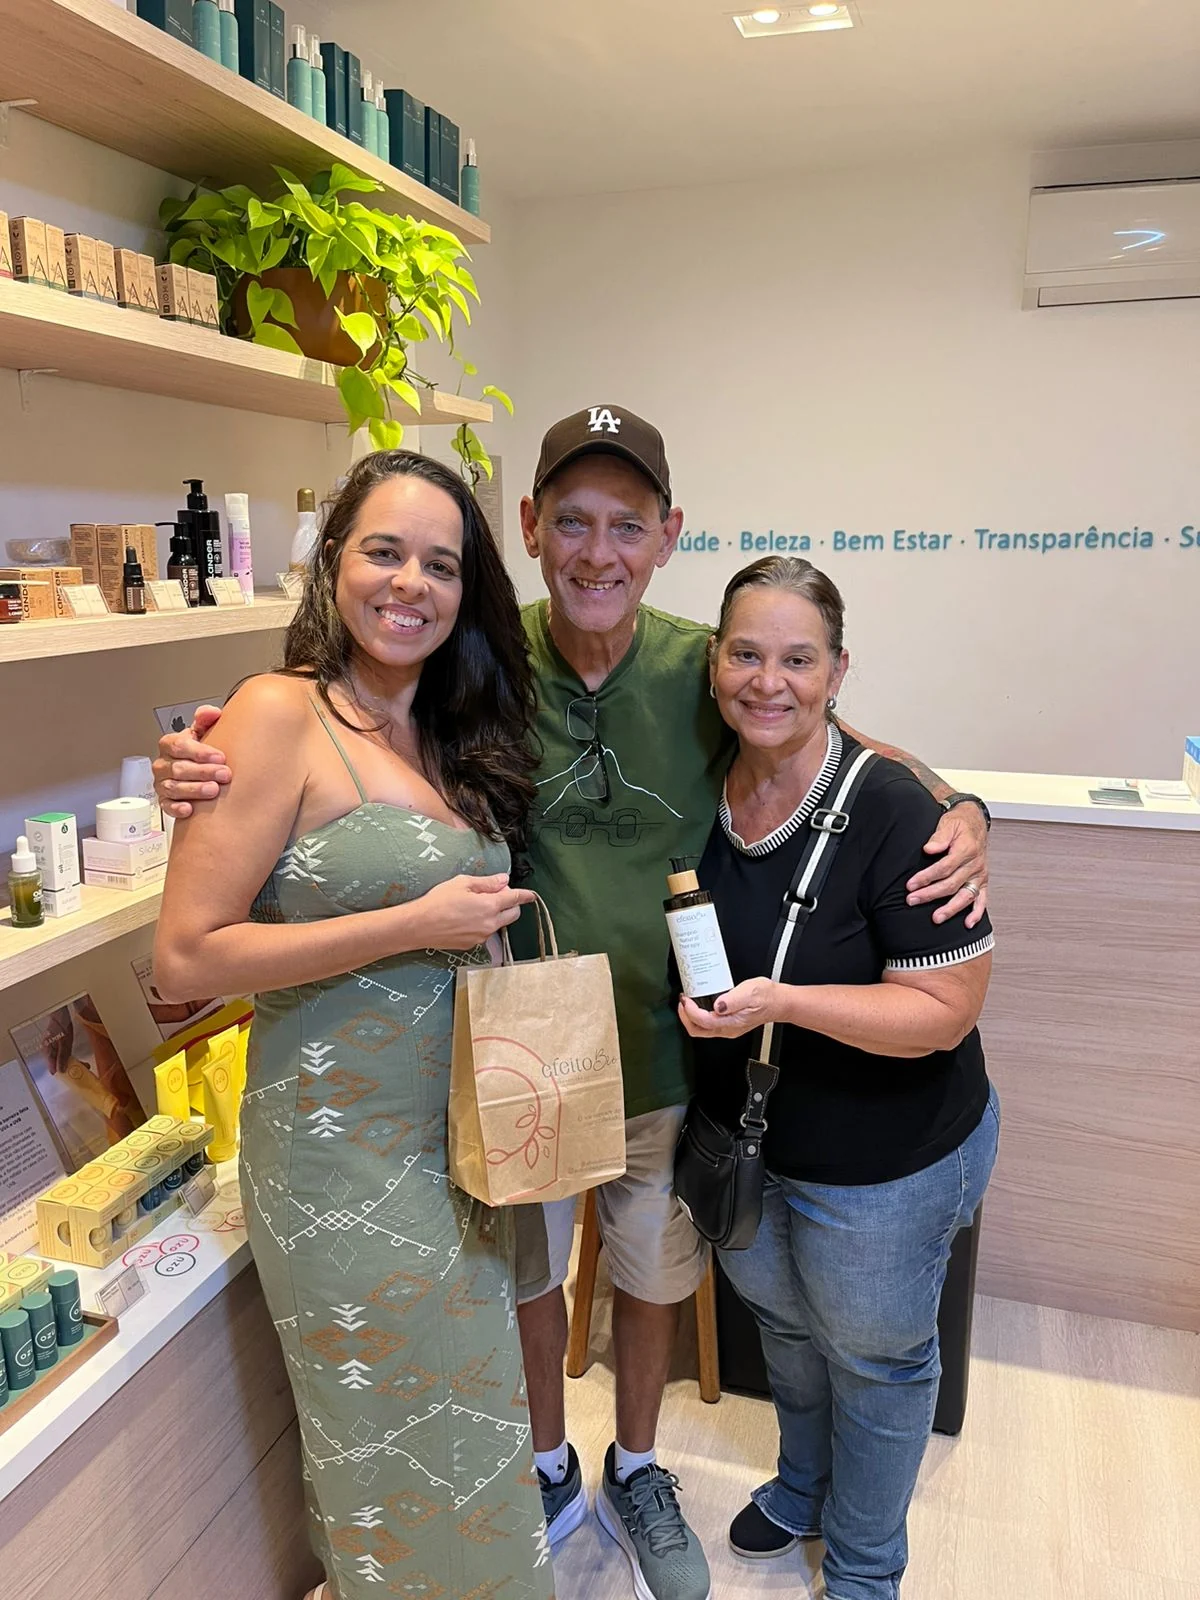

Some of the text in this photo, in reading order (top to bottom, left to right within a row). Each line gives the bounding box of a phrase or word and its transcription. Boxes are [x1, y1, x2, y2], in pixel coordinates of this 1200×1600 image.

[587, 407, 621, 434] LA
[676, 530, 720, 551] úde
[740, 530, 811, 551] Beleza
[833, 530, 884, 551] Bem
[893, 529, 953, 551] Estar
[974, 525, 1154, 554] Transparência
